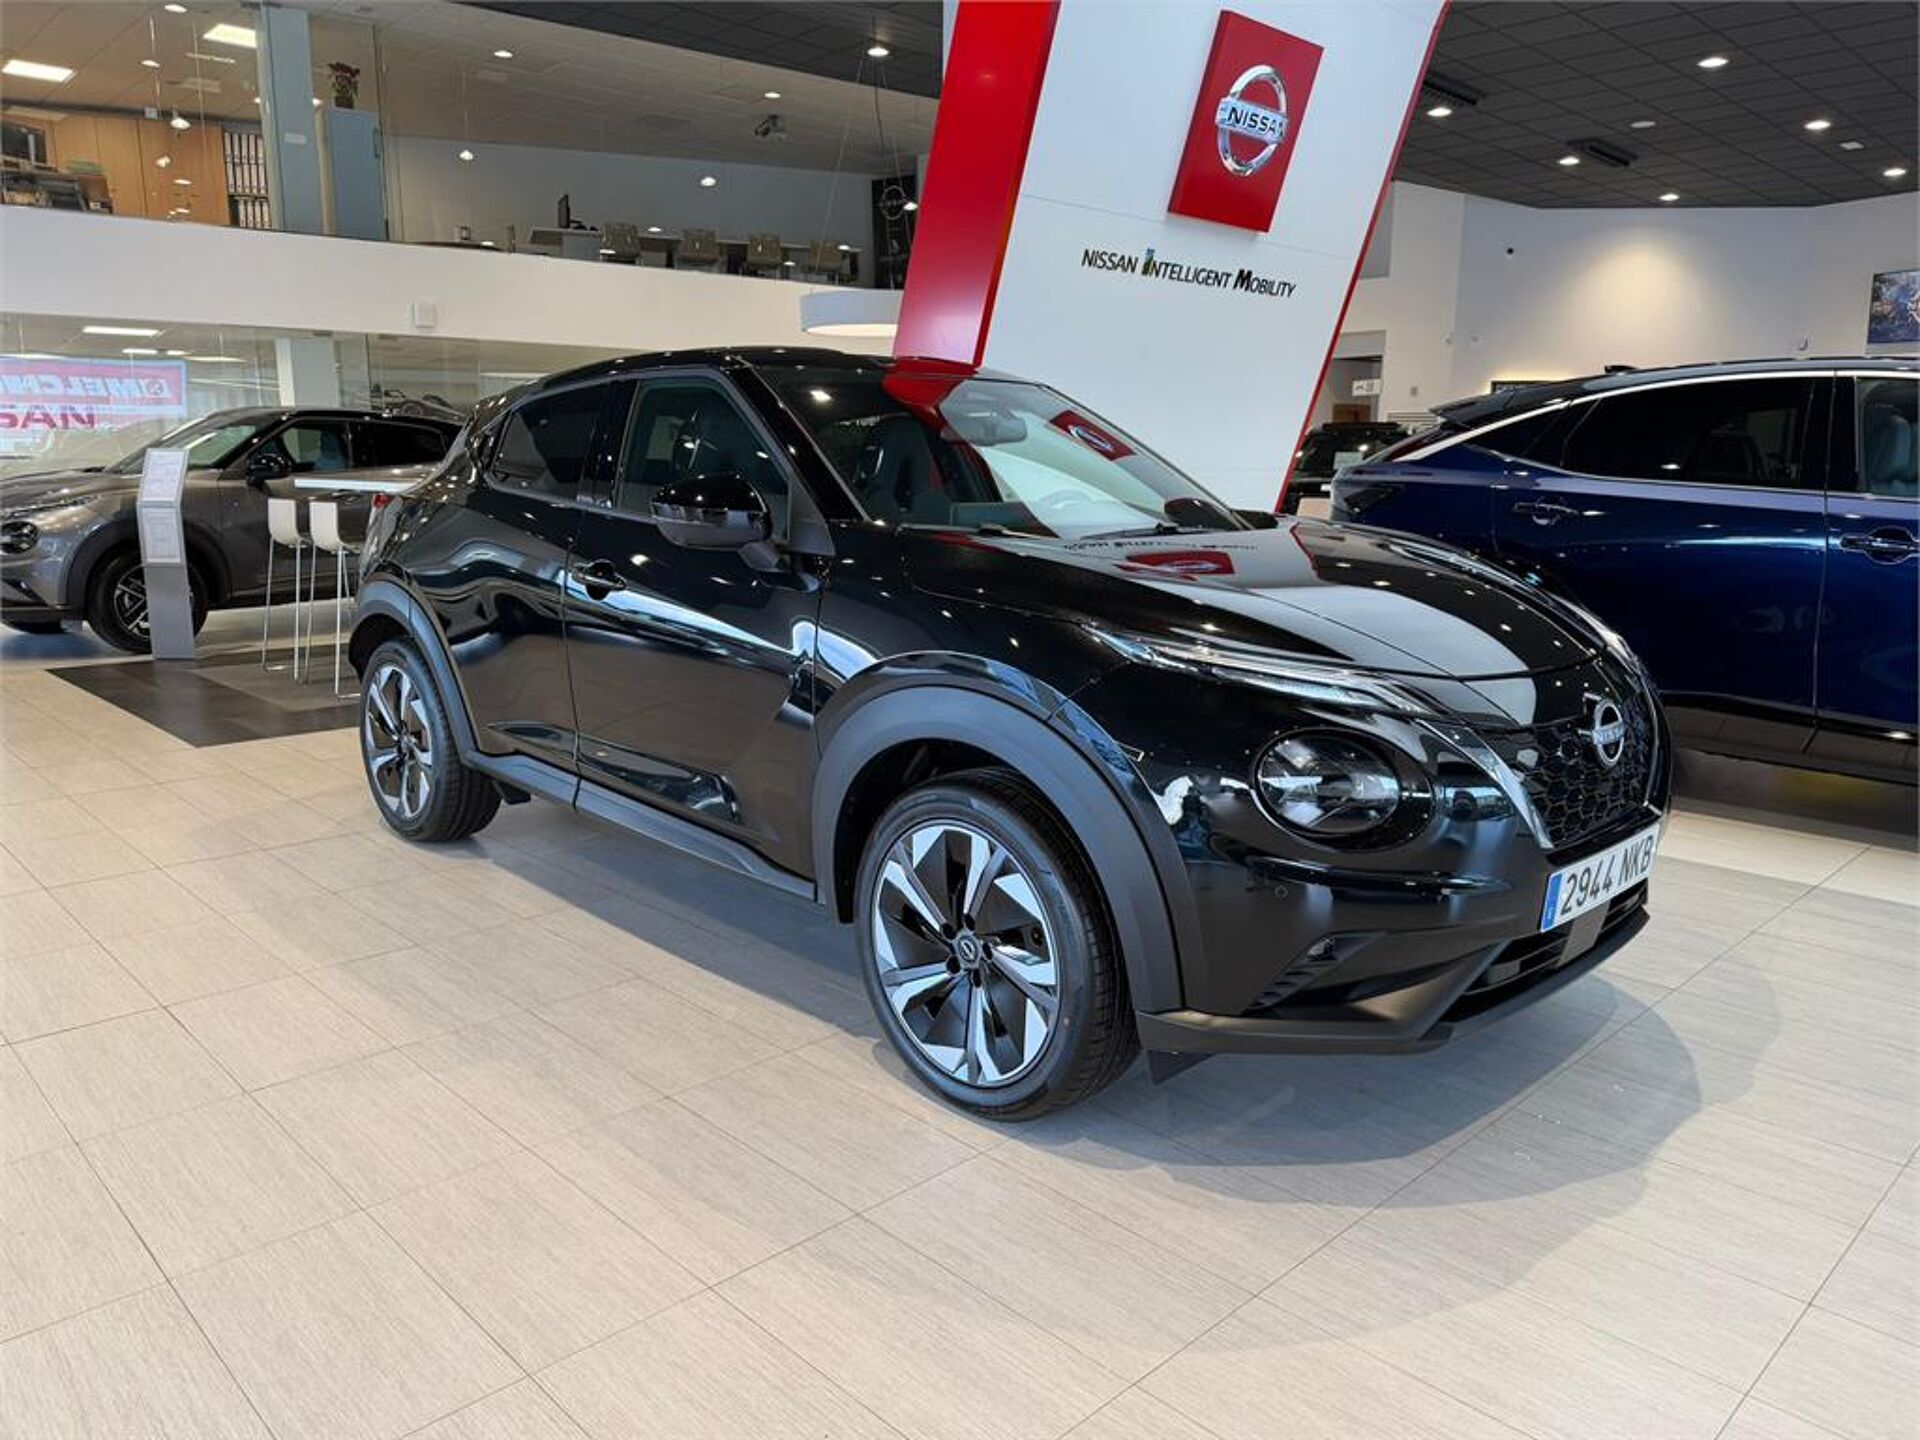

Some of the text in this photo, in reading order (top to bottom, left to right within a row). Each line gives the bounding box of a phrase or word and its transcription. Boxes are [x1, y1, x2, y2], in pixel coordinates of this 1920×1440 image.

[1081, 248, 1296, 298] NISSAN INTELLIGENT MOBILITY
[1560, 834, 1655, 916] 2944 NKB
